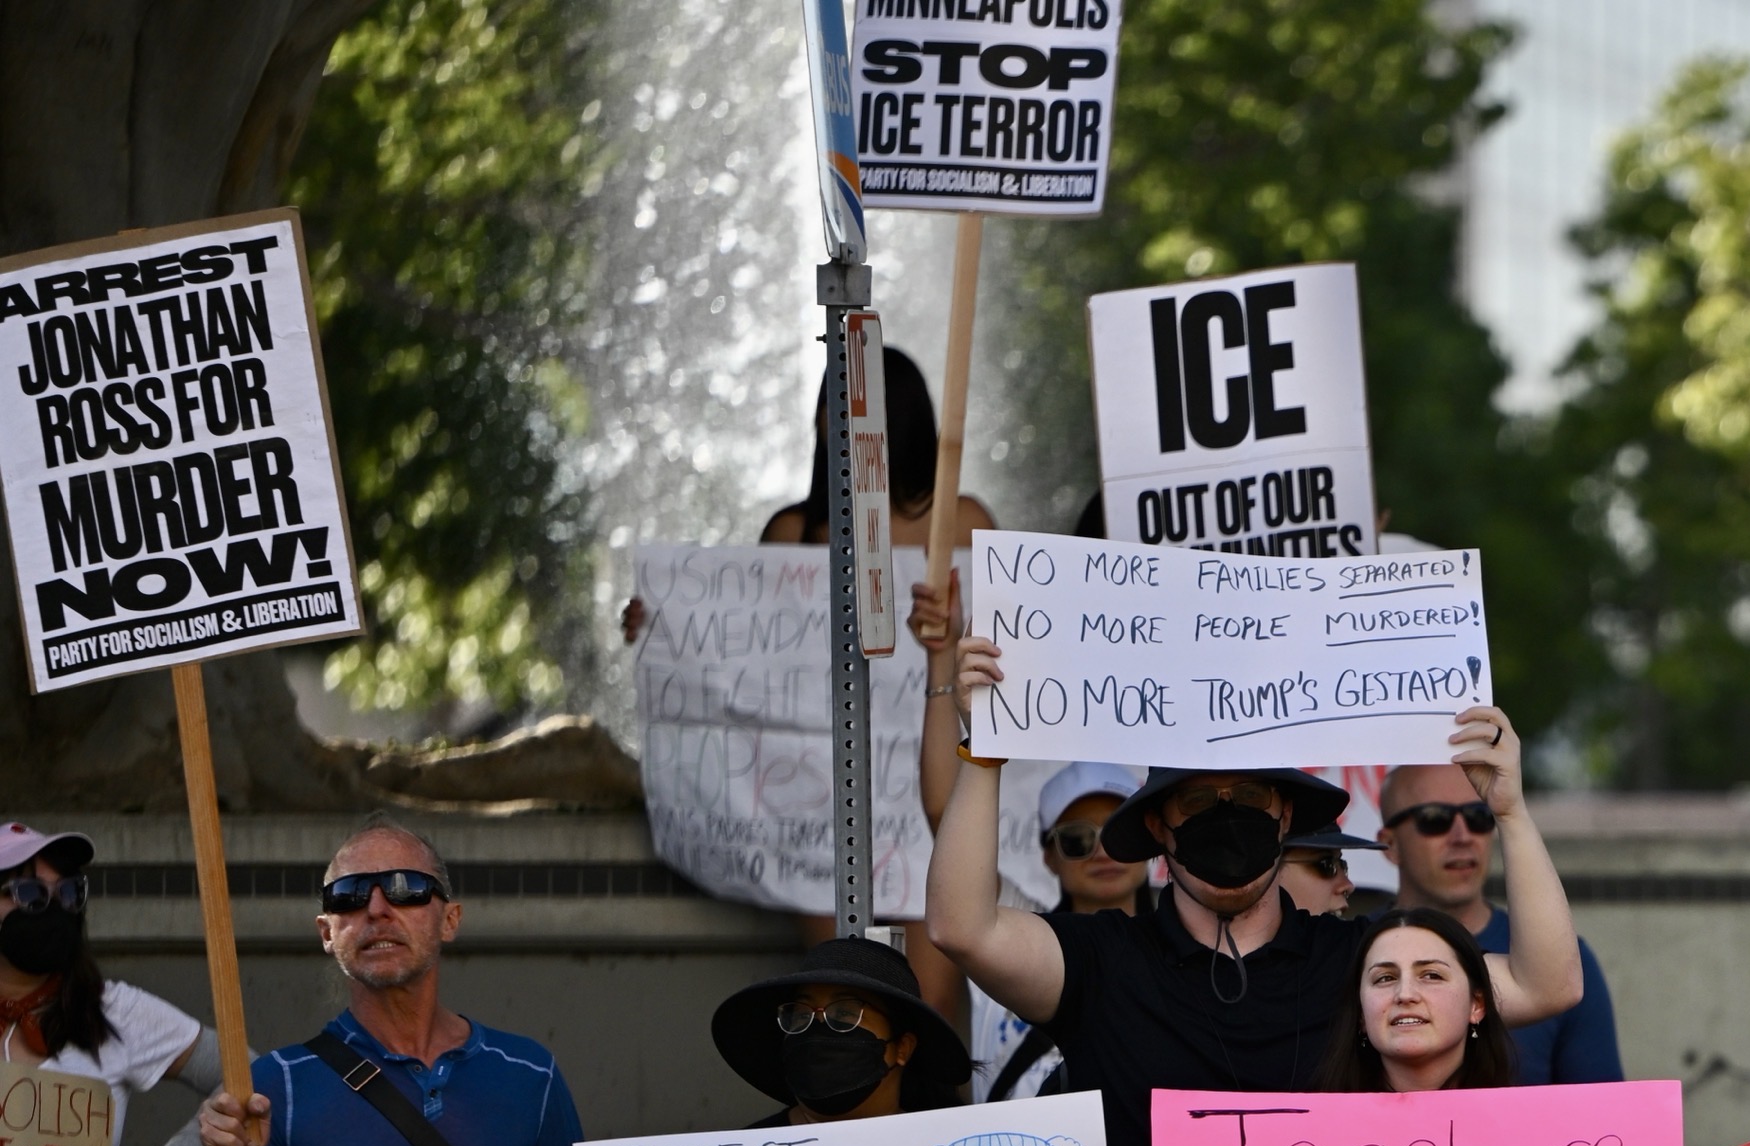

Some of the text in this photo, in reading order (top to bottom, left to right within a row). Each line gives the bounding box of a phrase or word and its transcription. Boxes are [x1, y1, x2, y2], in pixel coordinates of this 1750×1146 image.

[862, 39, 1108, 90] STOP
[858, 92, 1102, 163] ICE TERROR
[860, 167, 1094, 198] PARTY FOR SOCIALISM & LIBERATION
[0, 236, 278, 323] ARREST
[18, 280, 274, 396] JONATHAN
[849, 330, 864, 401] NO
[1150, 280, 1306, 454] ICE
[36, 357, 275, 468] ROSS FOR
[854, 432, 887, 494] STOPPING
[38, 437, 304, 573] MURDER
[867, 508, 879, 553] ANY
[1138, 466, 1336, 545] OUT OF OUR
[35, 527, 334, 632] NOW!
[869, 569, 884, 614] TIME
[987, 544, 1056, 587] NO
[1084, 552, 1161, 587] MORE
[1198, 559, 1327, 593] FAMILIES
[49, 593, 338, 670] PARTY FOR SOCIALISM & LIBERATION
[993, 600, 1481, 646] NO MORE PEOPLE MURDERED!
[989, 677, 1068, 735] NO
[1082, 674, 1176, 727] MORE
[1191, 670, 1318, 722] TRUMP'S
[1334, 655, 1482, 709] GESTAPO!
